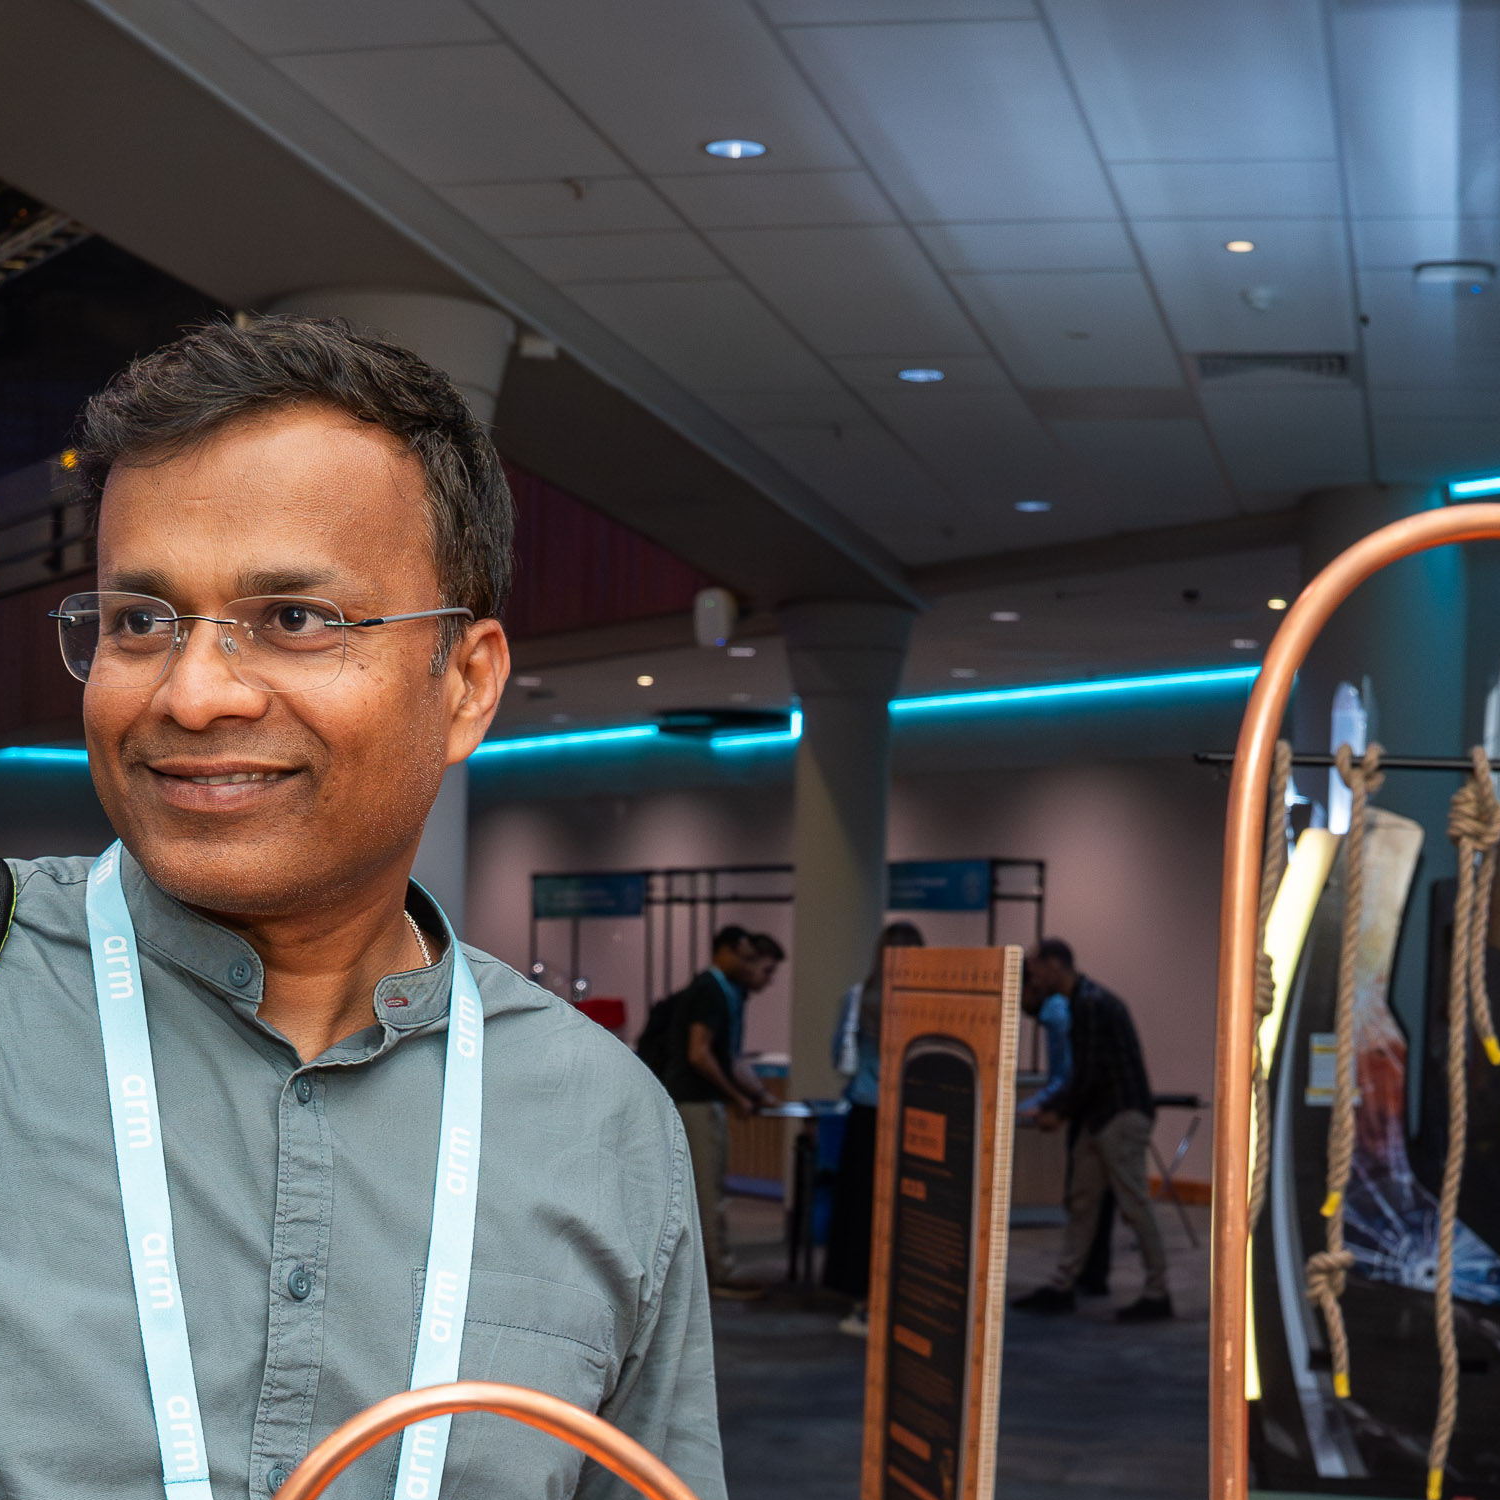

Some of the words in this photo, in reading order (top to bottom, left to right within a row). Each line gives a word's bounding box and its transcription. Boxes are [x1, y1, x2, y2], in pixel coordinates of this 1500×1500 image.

[102, 934, 134, 999] arm
[456, 995, 476, 1058] arm
[121, 1074, 153, 1149] arm
[447, 1126, 472, 1196] arm
[142, 1232, 175, 1310] arm
[430, 1271, 458, 1344] arm
[166, 1395, 200, 1474] arm
[406, 1423, 438, 1500] arm
